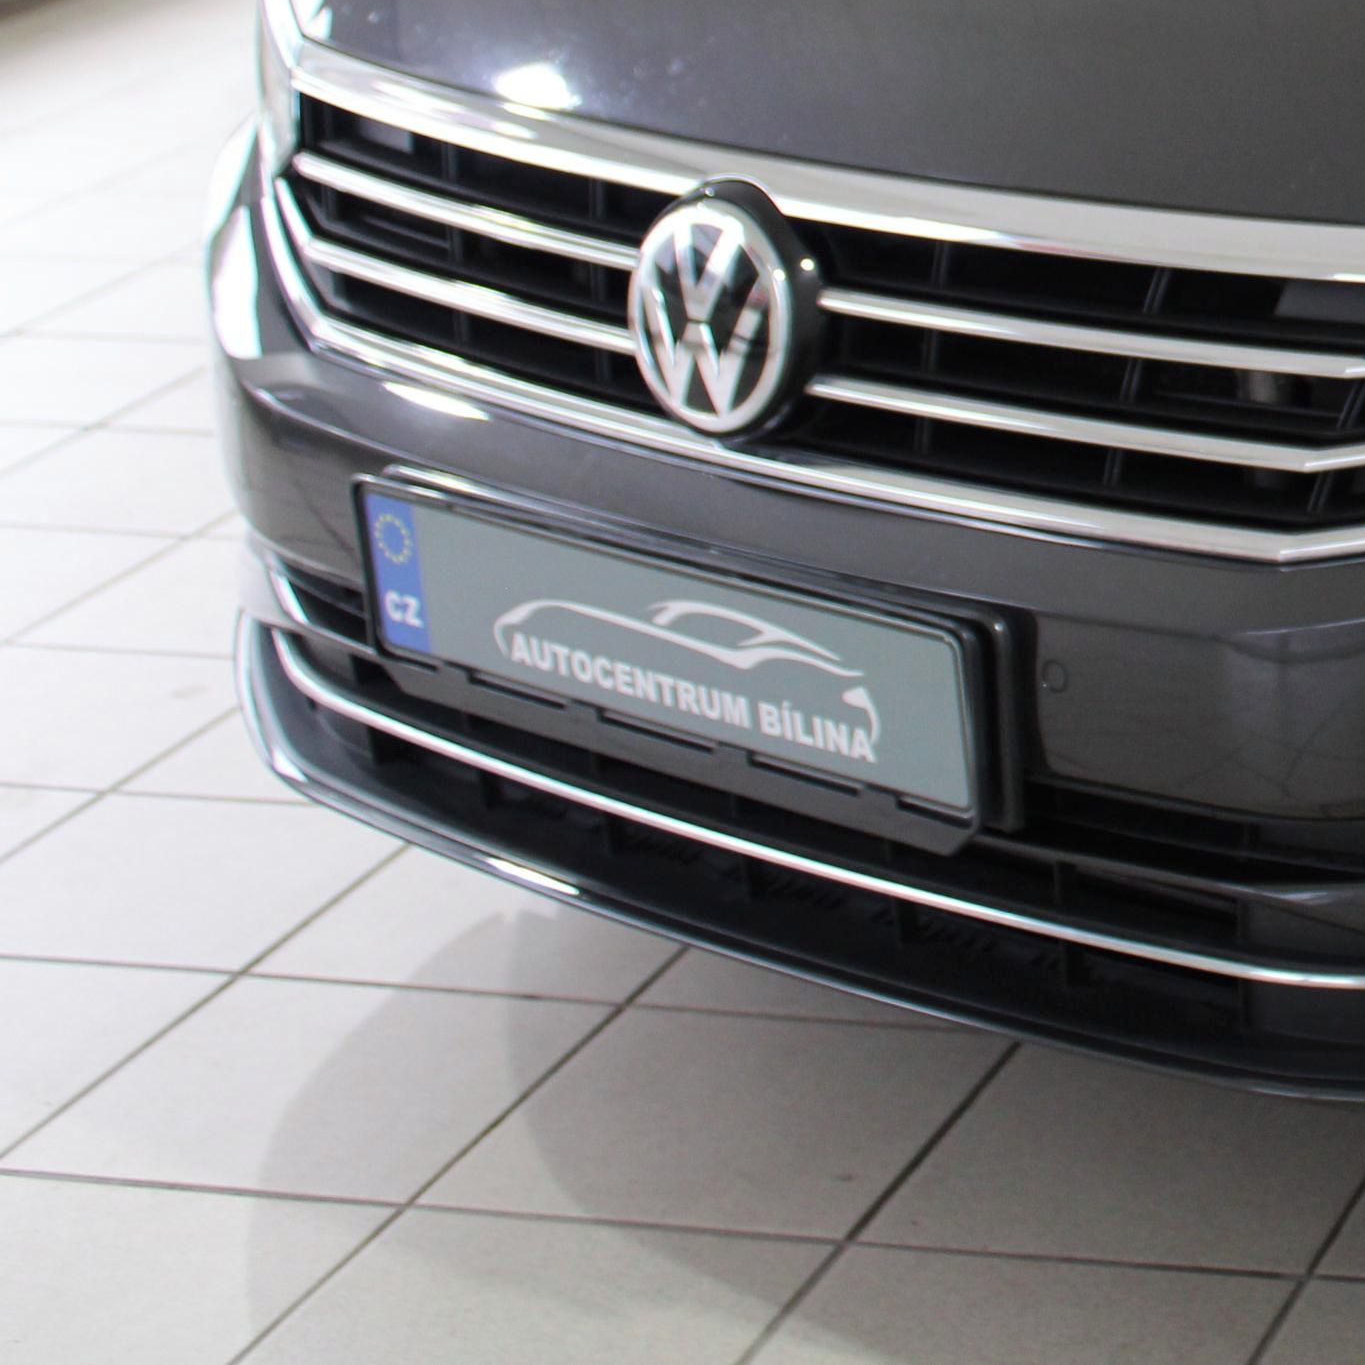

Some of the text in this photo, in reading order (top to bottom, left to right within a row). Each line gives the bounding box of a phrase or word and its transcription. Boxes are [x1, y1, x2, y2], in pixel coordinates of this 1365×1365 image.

[384, 591, 424, 628] CZ
[511, 632, 877, 763] AUTOCENTRUM BÍLINA
